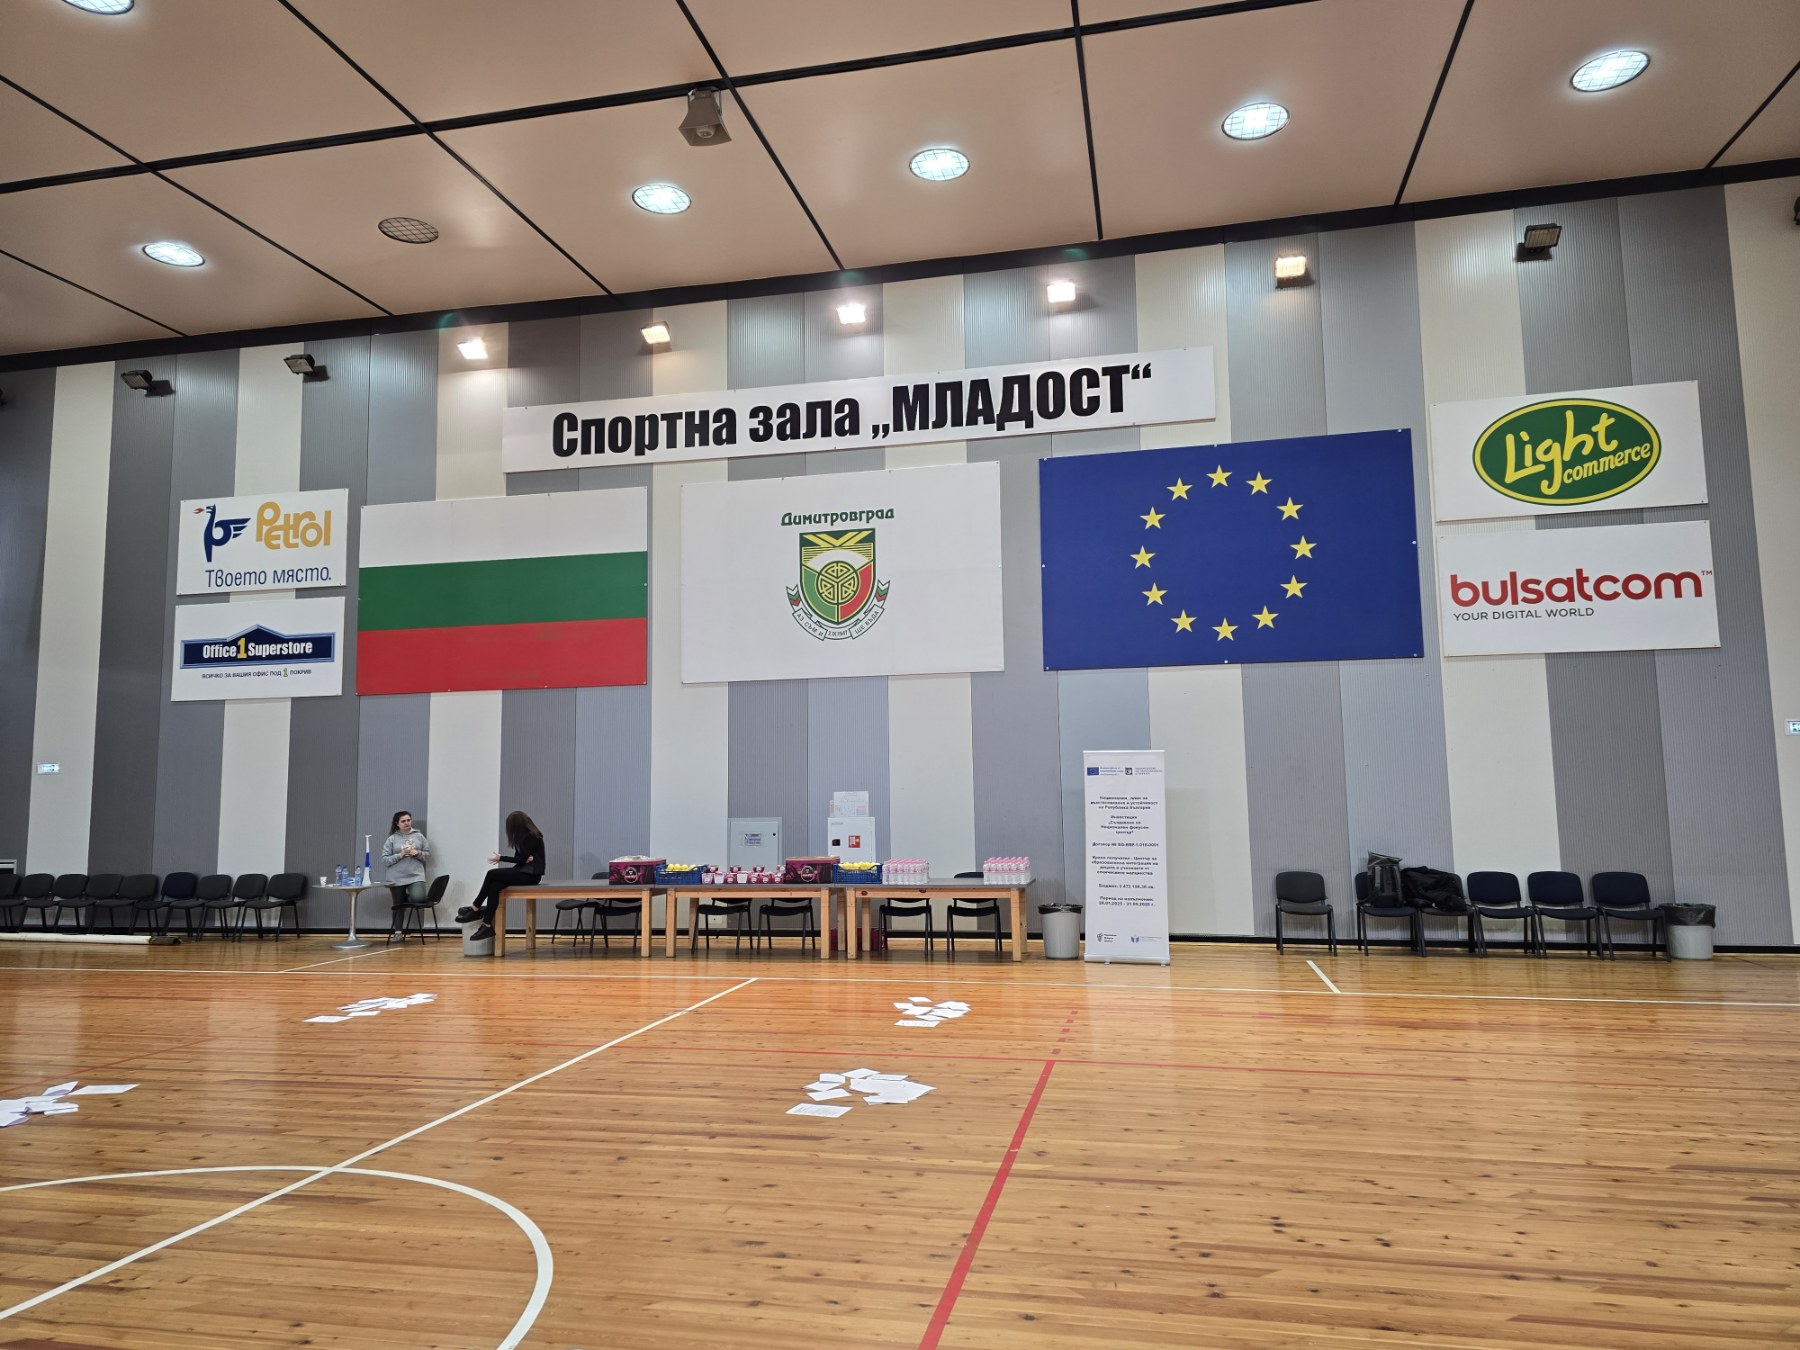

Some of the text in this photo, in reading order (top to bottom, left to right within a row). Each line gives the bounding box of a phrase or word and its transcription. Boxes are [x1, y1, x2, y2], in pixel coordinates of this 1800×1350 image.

[552, 362, 1152, 457] Спортна зала „МЛАДОСТ“
[1504, 409, 1619, 496] Light
[1562, 442, 1651, 484] commerce
[256, 501, 332, 550] Petrol
[780, 508, 896, 526] Димитровград
[204, 566, 332, 588] Твоето място.
[1450, 568, 1703, 608] bulsatcom
[1453, 608, 1595, 622] YOUR DIGITAL WORLD
[202, 644, 237, 658] Office
[248, 641, 313, 658] Superstore
